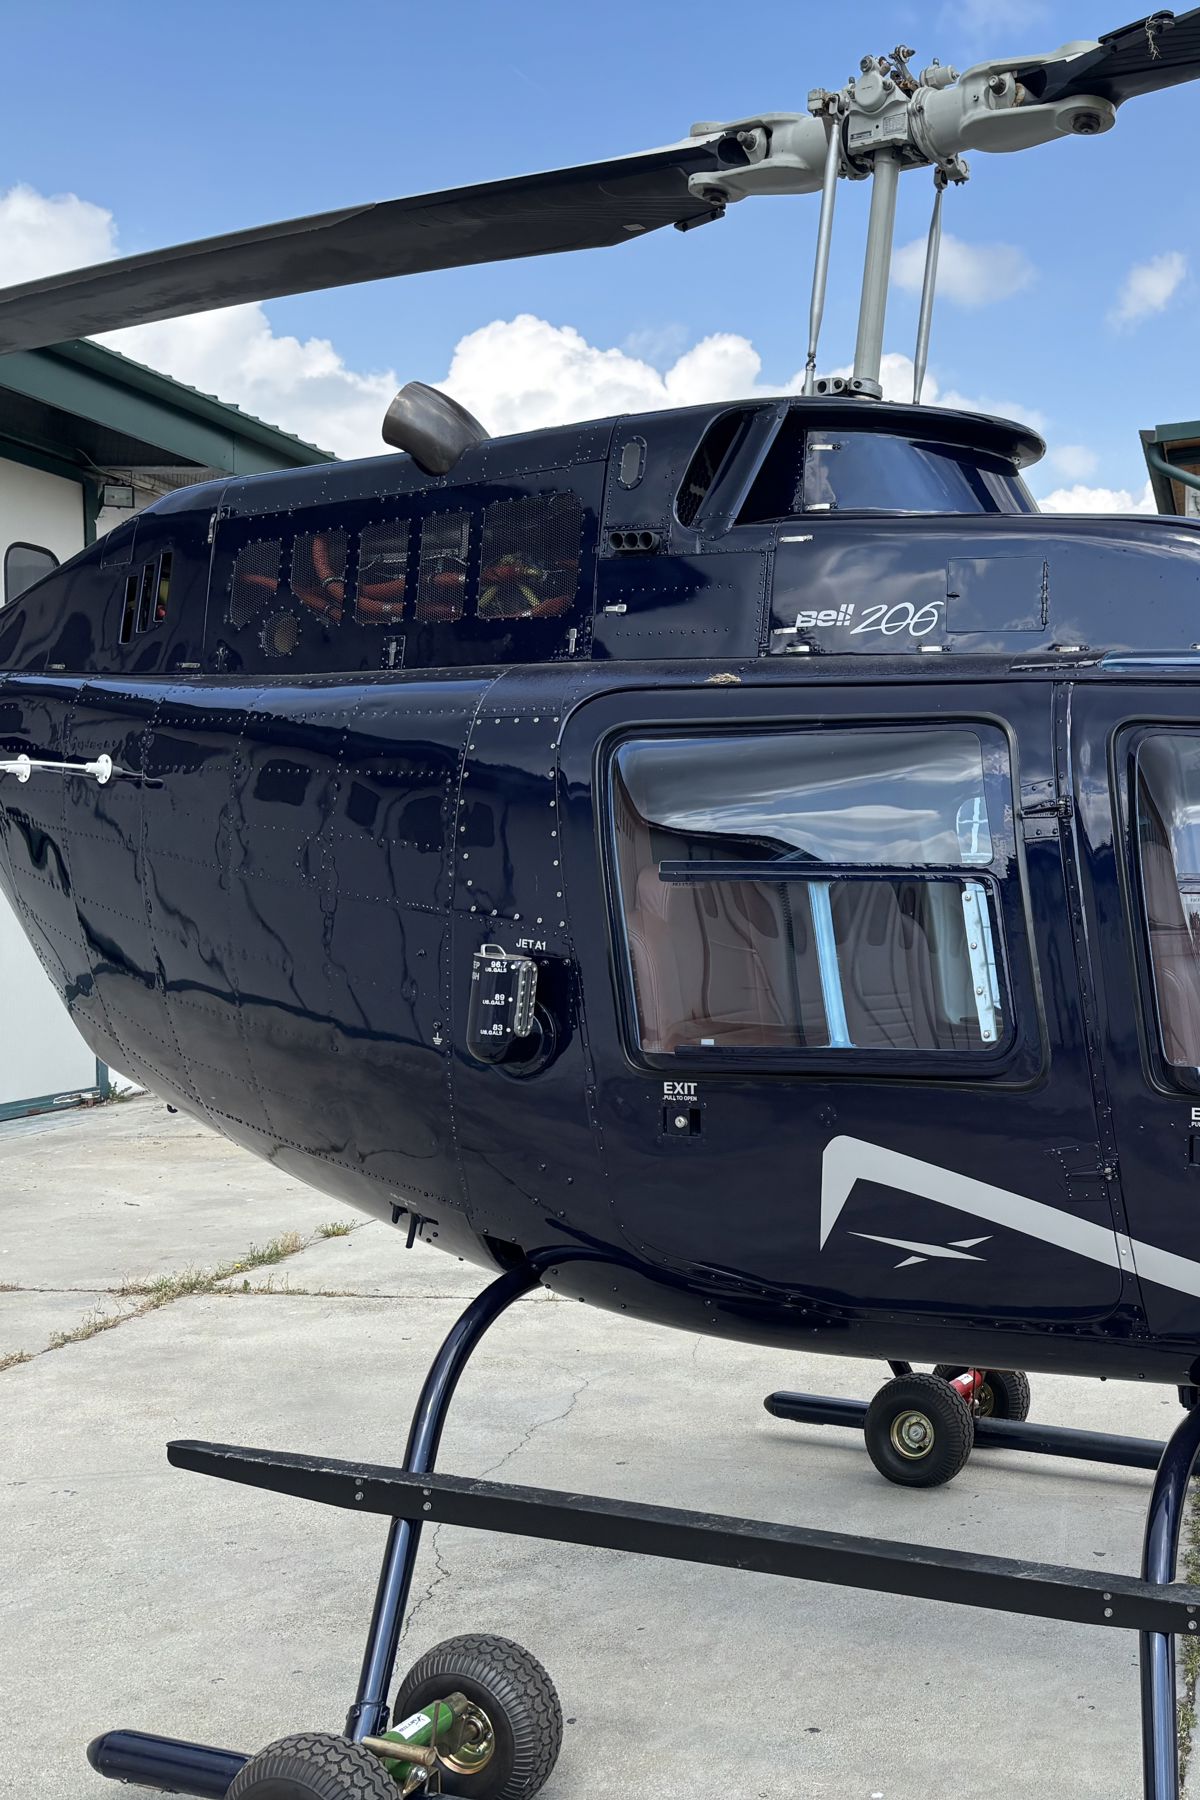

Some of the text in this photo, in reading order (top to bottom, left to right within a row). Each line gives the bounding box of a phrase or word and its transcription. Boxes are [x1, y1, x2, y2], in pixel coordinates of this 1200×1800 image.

[795, 600, 945, 637] Bell 206
[516, 938, 547, 951] JET A1
[663, 1082, 697, 1094] EXIT
